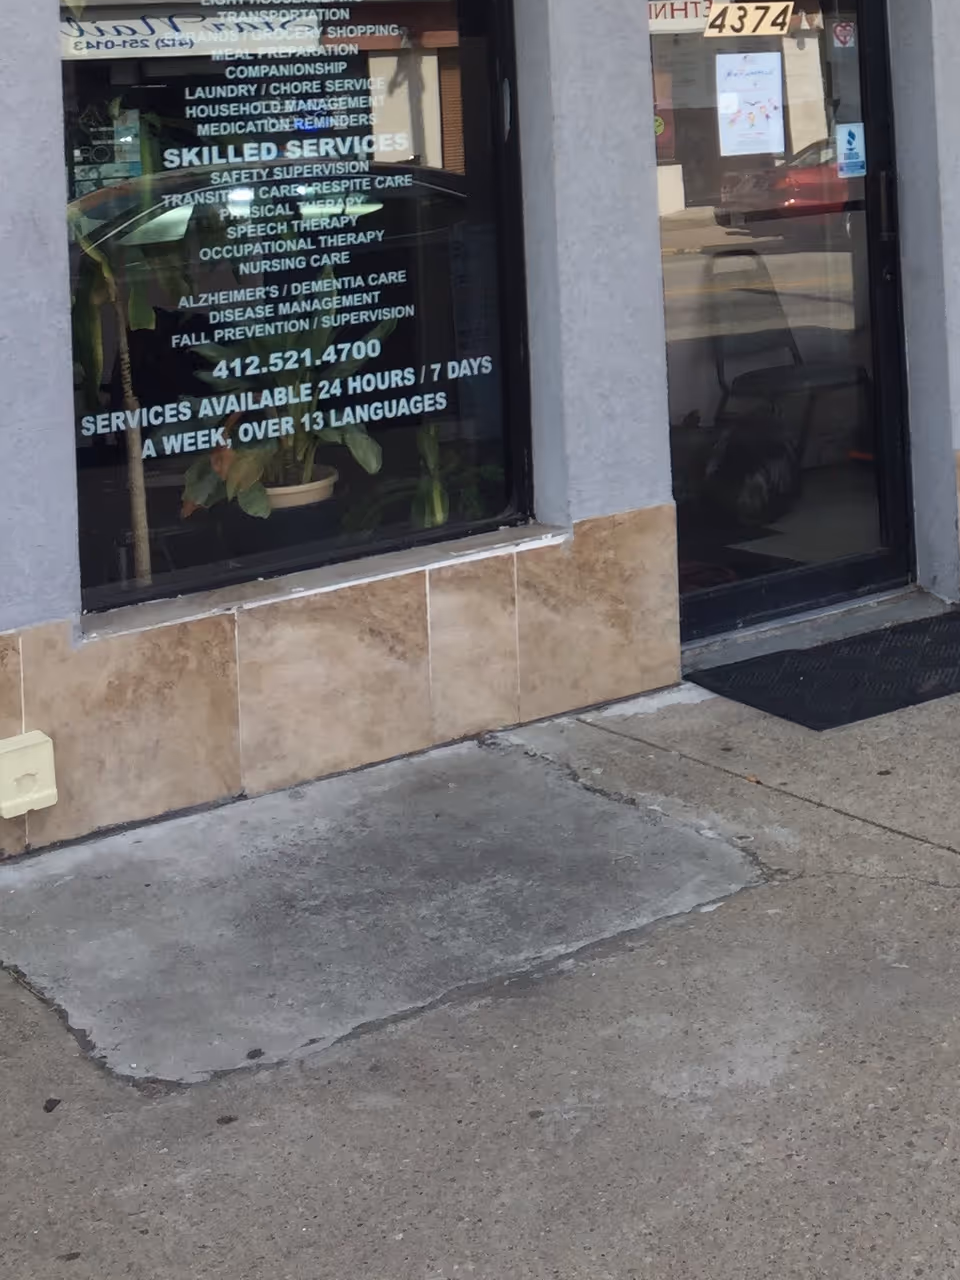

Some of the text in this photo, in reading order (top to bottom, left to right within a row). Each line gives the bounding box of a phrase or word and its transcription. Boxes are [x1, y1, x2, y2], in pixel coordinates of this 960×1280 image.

[217, 8, 350, 22] TRANSPORTATION
[708, 5, 790, 33] 4374
[328, 24, 398, 38] SHOPPING
[211, 44, 359, 61] MEAL PREPARATION
[225, 62, 348, 79] COMPANIONSHIP
[185, 84, 257, 100] LAUNDRY
[270, 81, 322, 96] CHORE
[325, 77, 385, 93] SERVICE
[185, 96, 385, 119] HOUSEHOLD MANAGEMENT
[197, 114, 377, 137] MEDICATION REMINDERS
[163, 133, 409, 168] SKILLED SERVICES
[210, 161, 370, 185] SAFETY SUPERVISION
[259, 186, 297, 200] CARE
[312, 178, 371, 194] RESPITE
[375, 174, 412, 189] CARE
[297, 196, 364, 212] THERAPY
[226, 215, 358, 239] SPEECH THERAPY
[199, 230, 385, 260] OCCUPATIONAL THERAPY
[239, 252, 350, 275] NURSING CARE
[178, 286, 279, 308] ALZHEIMER'S
[291, 276, 365, 296] DEMENTIA
[368, 270, 407, 286] CARE
[209, 291, 381, 324] DISEASE MANAGEMENT
[171, 333, 209, 348] FALL
[214, 318, 310, 342] PREVENTION
[321, 305, 415, 328] SUPERVISION
[212, 339, 381, 379] 412.521.4700
[81, 401, 192, 436] SERVICES
[199, 382, 313, 419] AVAILABLE
[317, 378, 342, 399] 24
[347, 367, 416, 395] HOURS
[430, 364, 441, 381] 7
[447, 356, 492, 379] DAYS
[141, 391, 448, 459] A WEEK, OVER 13 LANGUAGES
